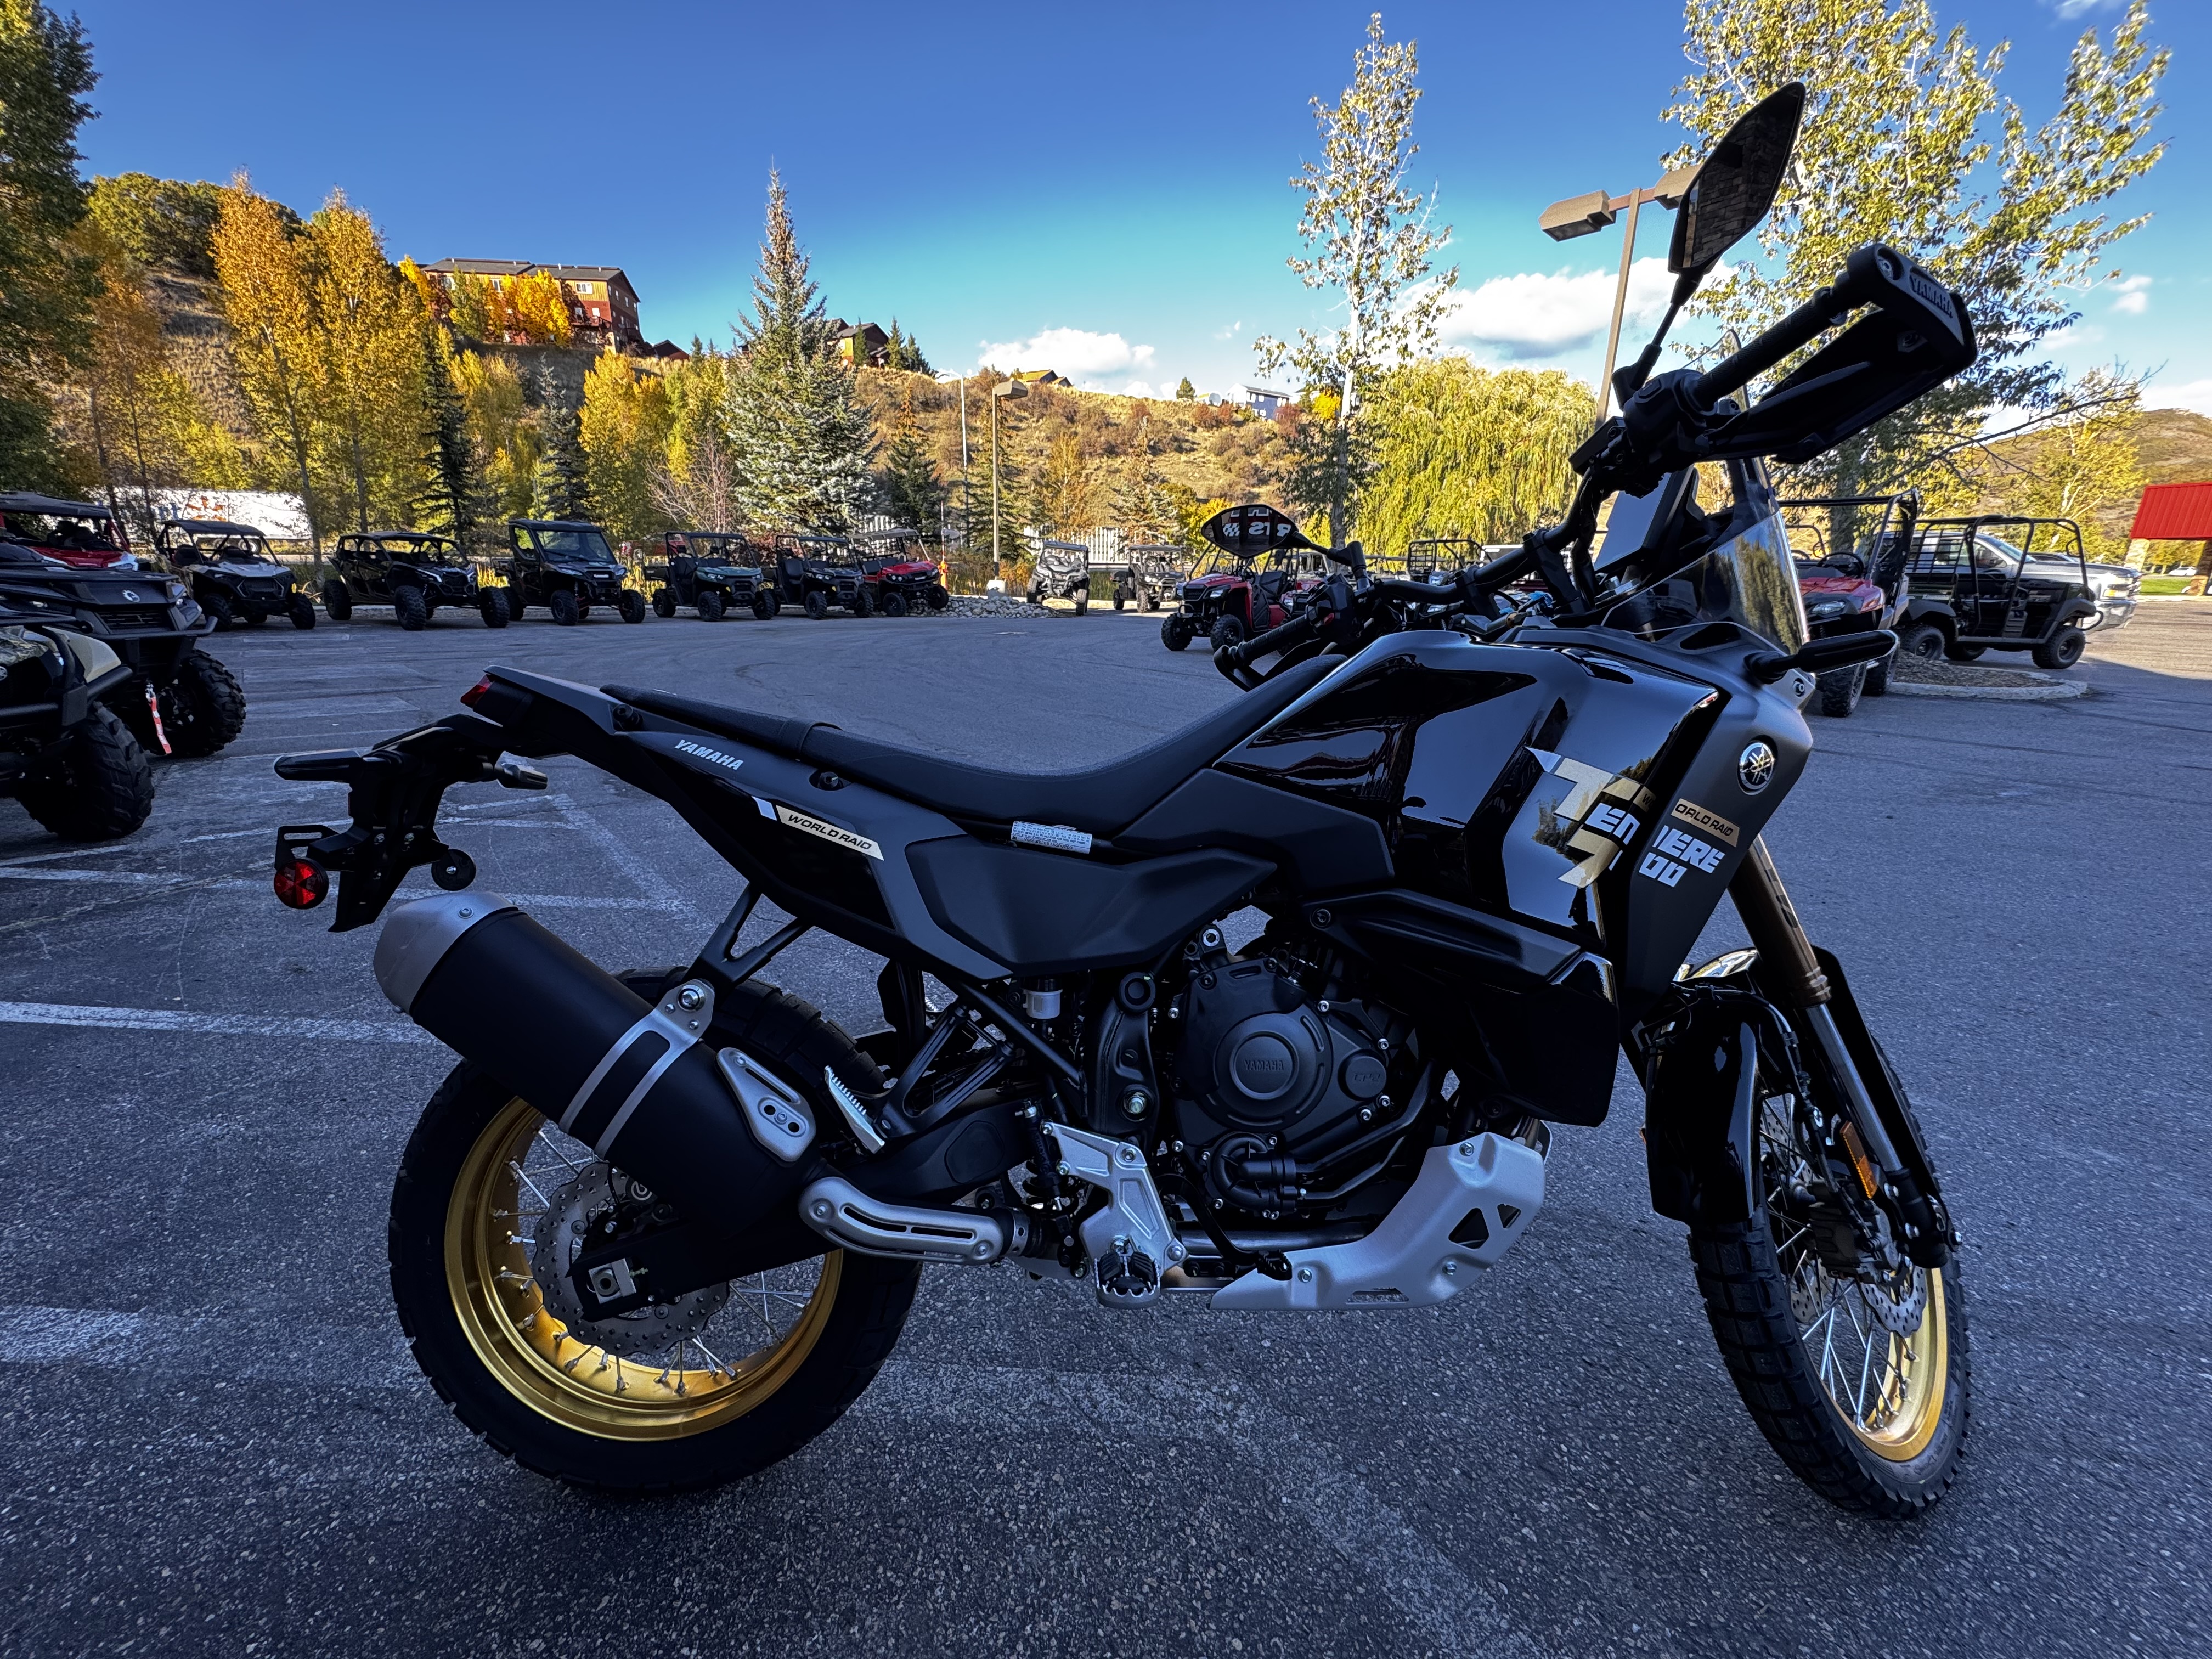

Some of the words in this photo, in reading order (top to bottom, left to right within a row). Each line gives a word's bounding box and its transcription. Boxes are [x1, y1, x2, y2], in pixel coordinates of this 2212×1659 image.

[674, 740, 744, 770] YAMAHA
[788, 814, 839, 838] WORLD
[838, 833, 872, 850] RAID
[1710, 819, 1734, 838] RAID
[1244, 1059, 1284, 1071] YAMAHA
